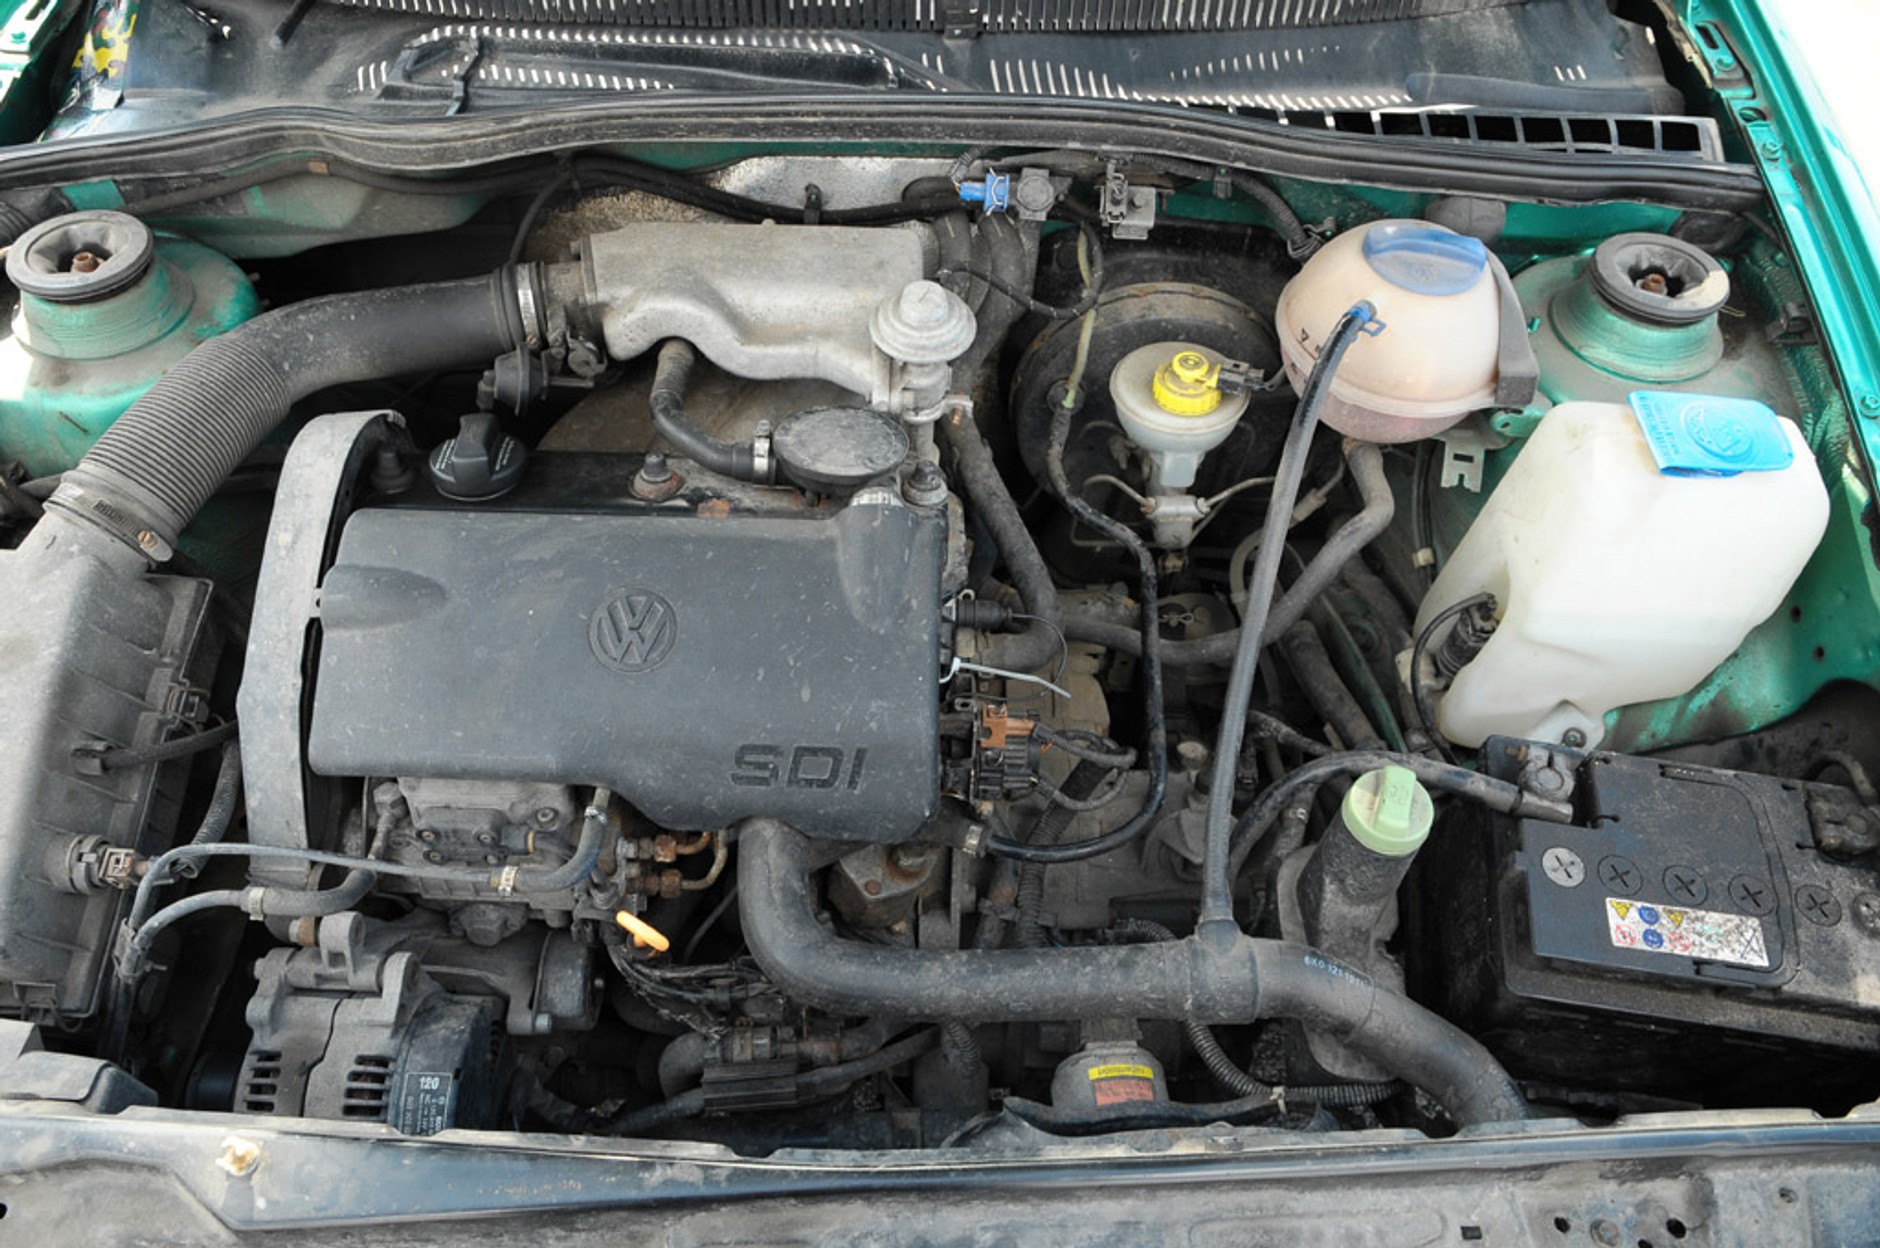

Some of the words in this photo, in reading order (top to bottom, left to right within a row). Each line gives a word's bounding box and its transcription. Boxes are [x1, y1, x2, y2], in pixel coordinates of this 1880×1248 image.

[597, 592, 672, 668] VW
[730, 743, 868, 791] SDI
[420, 1076, 440, 1090] 120
